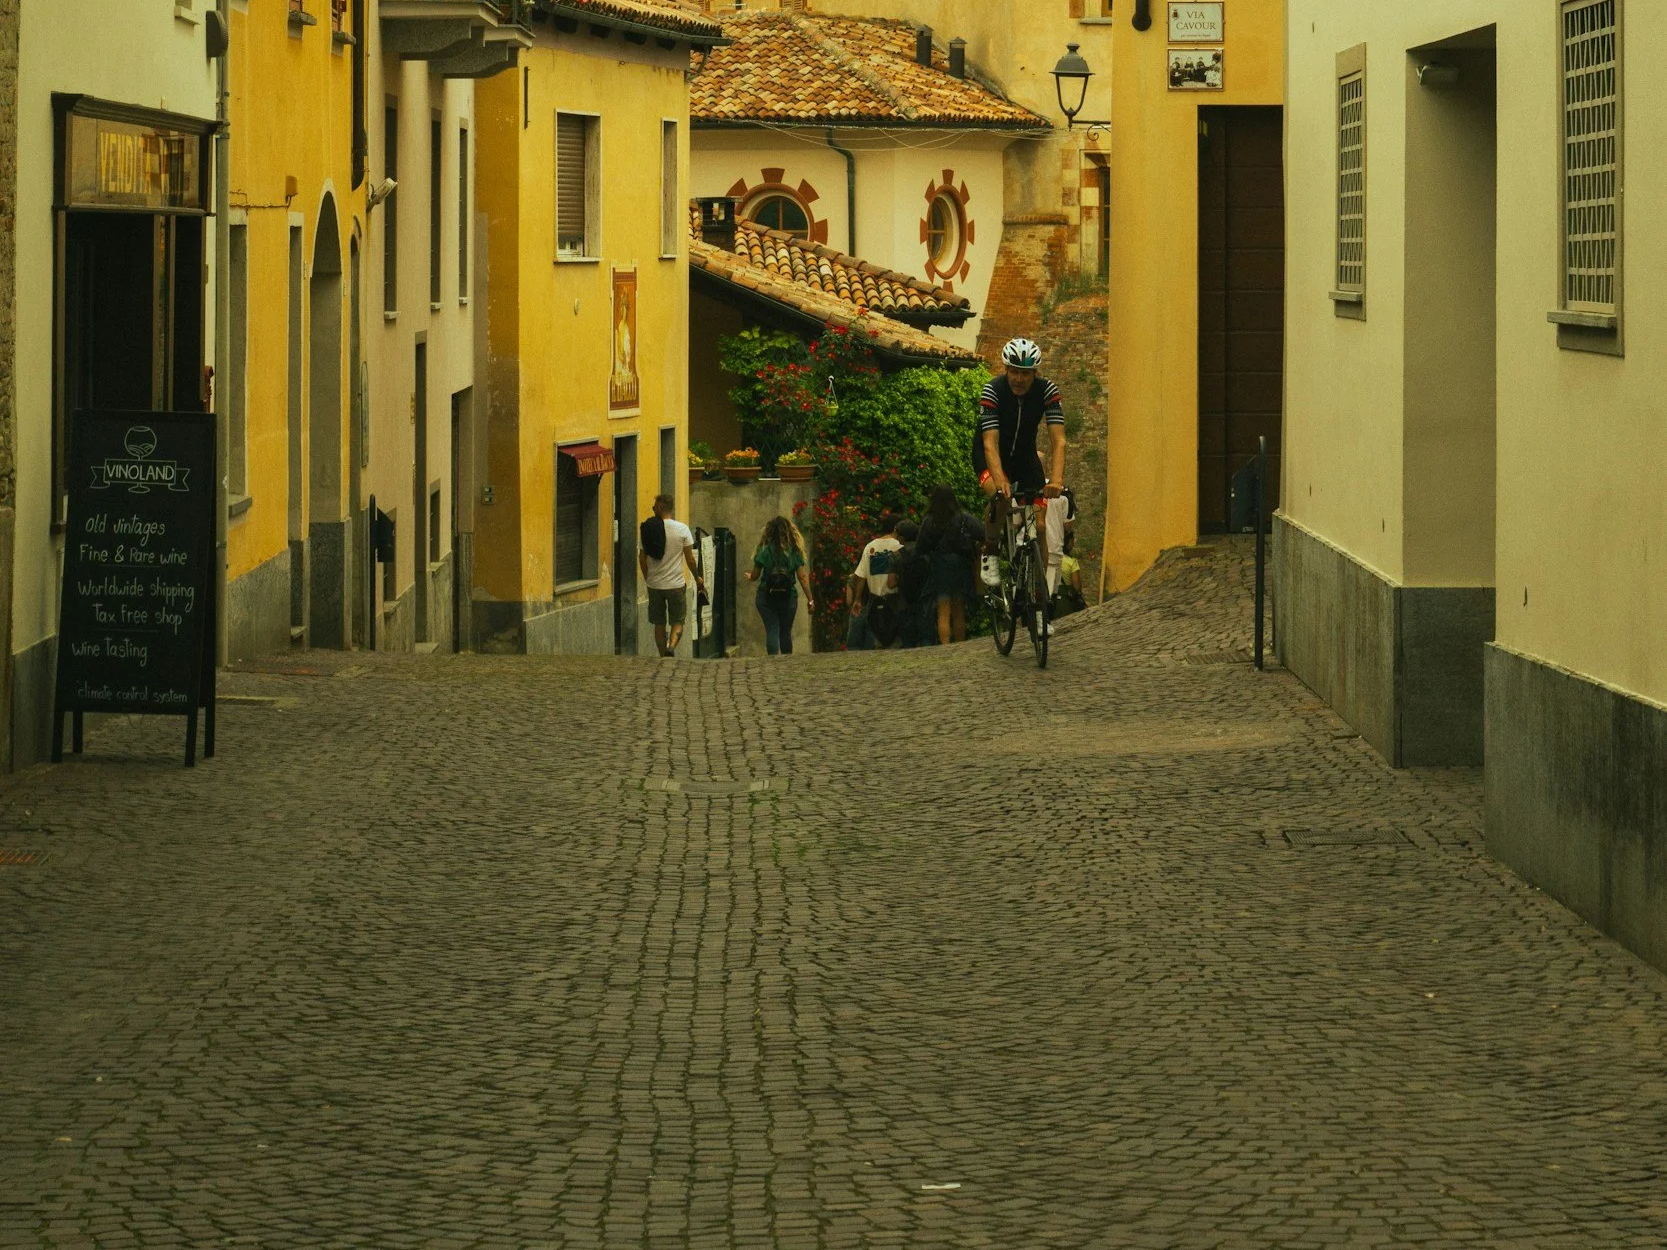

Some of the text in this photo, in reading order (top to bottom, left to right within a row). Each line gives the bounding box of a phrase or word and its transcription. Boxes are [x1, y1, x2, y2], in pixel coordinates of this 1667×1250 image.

[1186, 11, 1205, 19] VIA
[1176, 22, 1216, 30] CAVOUR
[106, 464, 175, 481] VINOLAND
[79, 544, 188, 565] Fine & Rare wine
[77, 575, 195, 613] Worldwide shipping
[92, 603, 116, 623] Tax
[155, 606, 183, 635] shop
[116, 686, 148, 700] control
[153, 687, 188, 704] system
